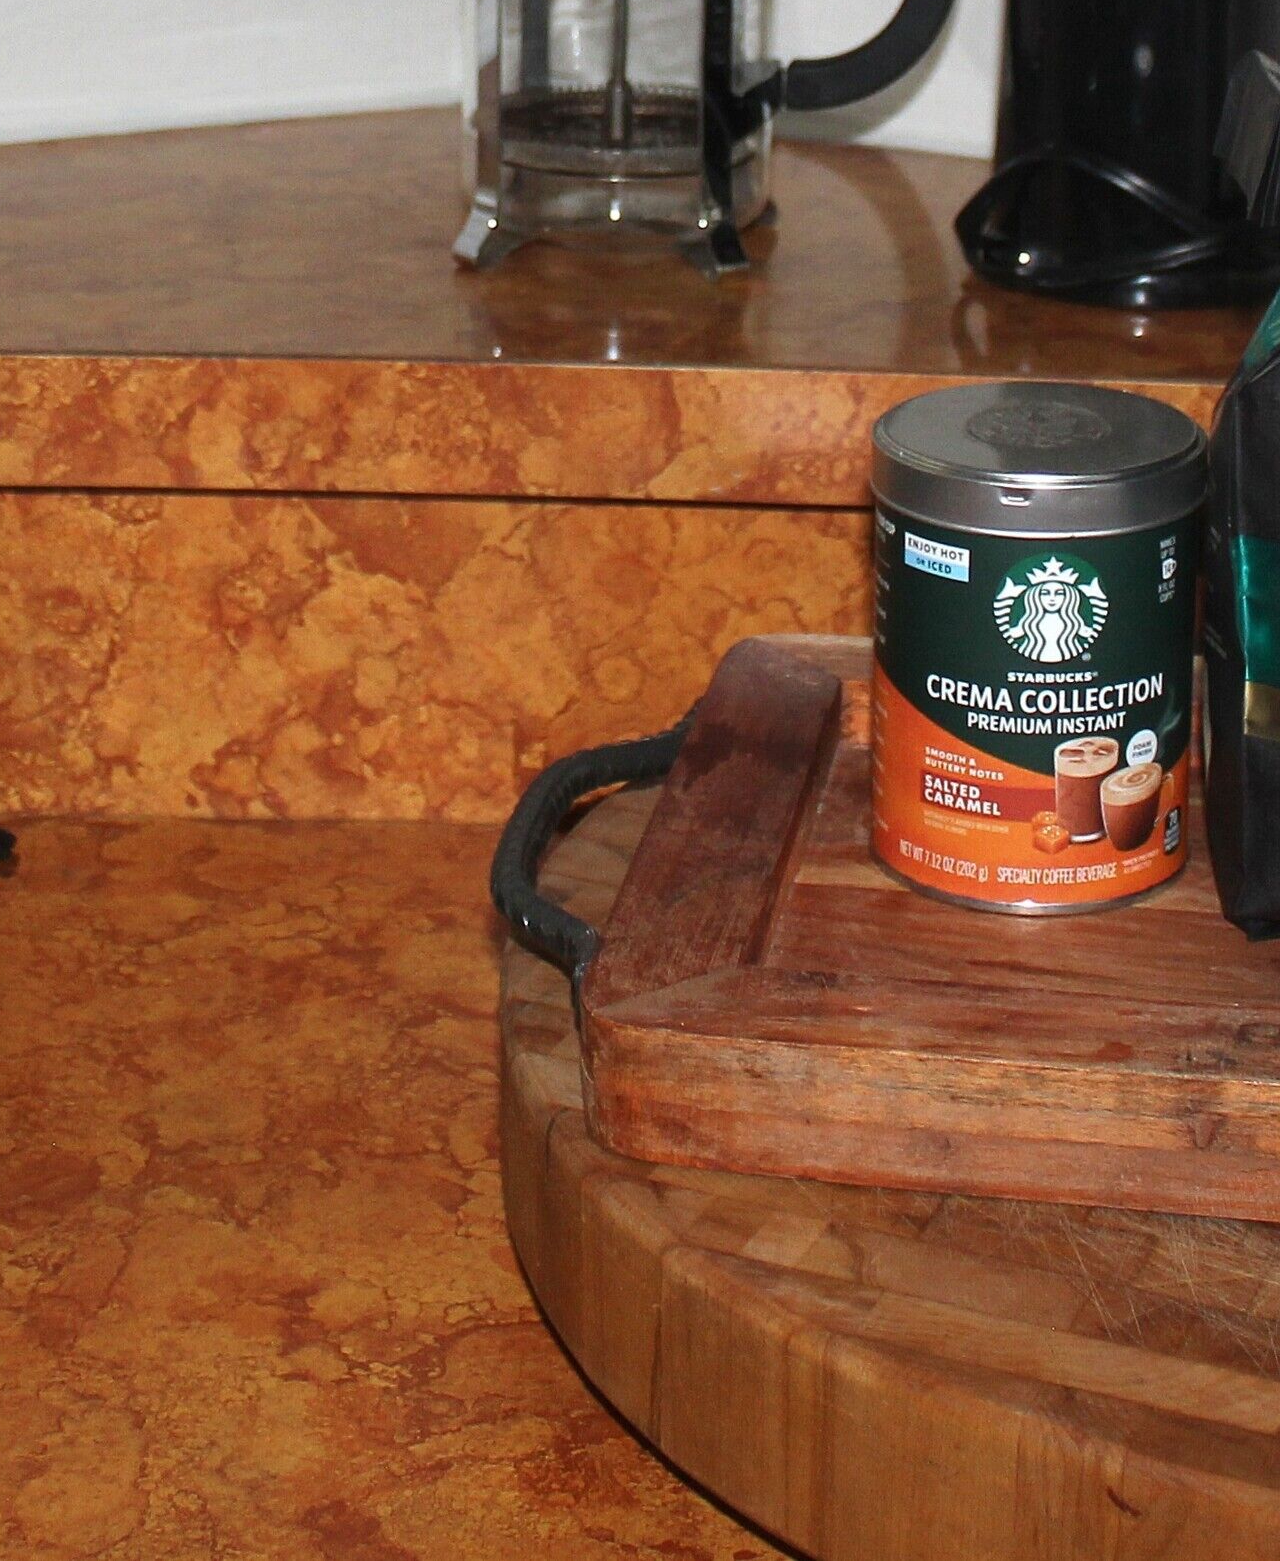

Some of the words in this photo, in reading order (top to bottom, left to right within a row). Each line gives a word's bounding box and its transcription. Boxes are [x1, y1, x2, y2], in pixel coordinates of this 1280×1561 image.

[908, 537, 937, 555] ENJOY
[940, 548, 964, 561] HOT
[928, 561, 952, 574] ICED
[1007, 671, 1093, 683] STARBUCKS
[926, 674, 1014, 713] CREMA
[1020, 673, 1164, 714] COLLECTION
[967, 711, 1052, 735] PREMIUM
[1056, 711, 1126, 735] INSTANT
[925, 746, 966, 765] SMOOTH
[925, 757, 966, 774] BUTTERY
[969, 769, 1004, 781] NOTES
[924, 774, 980, 799] SALTED
[924, 789, 1001, 815] CARAMEL
[925, 850, 941, 869] 7.12
[942, 856, 954, 873] OZ
[956, 860, 977, 879] (202
[997, 867, 1043, 885] SPECIALTY
[1043, 868, 1074, 885] COFFEE
[1076, 862, 1118, 882] BEVERAGE
